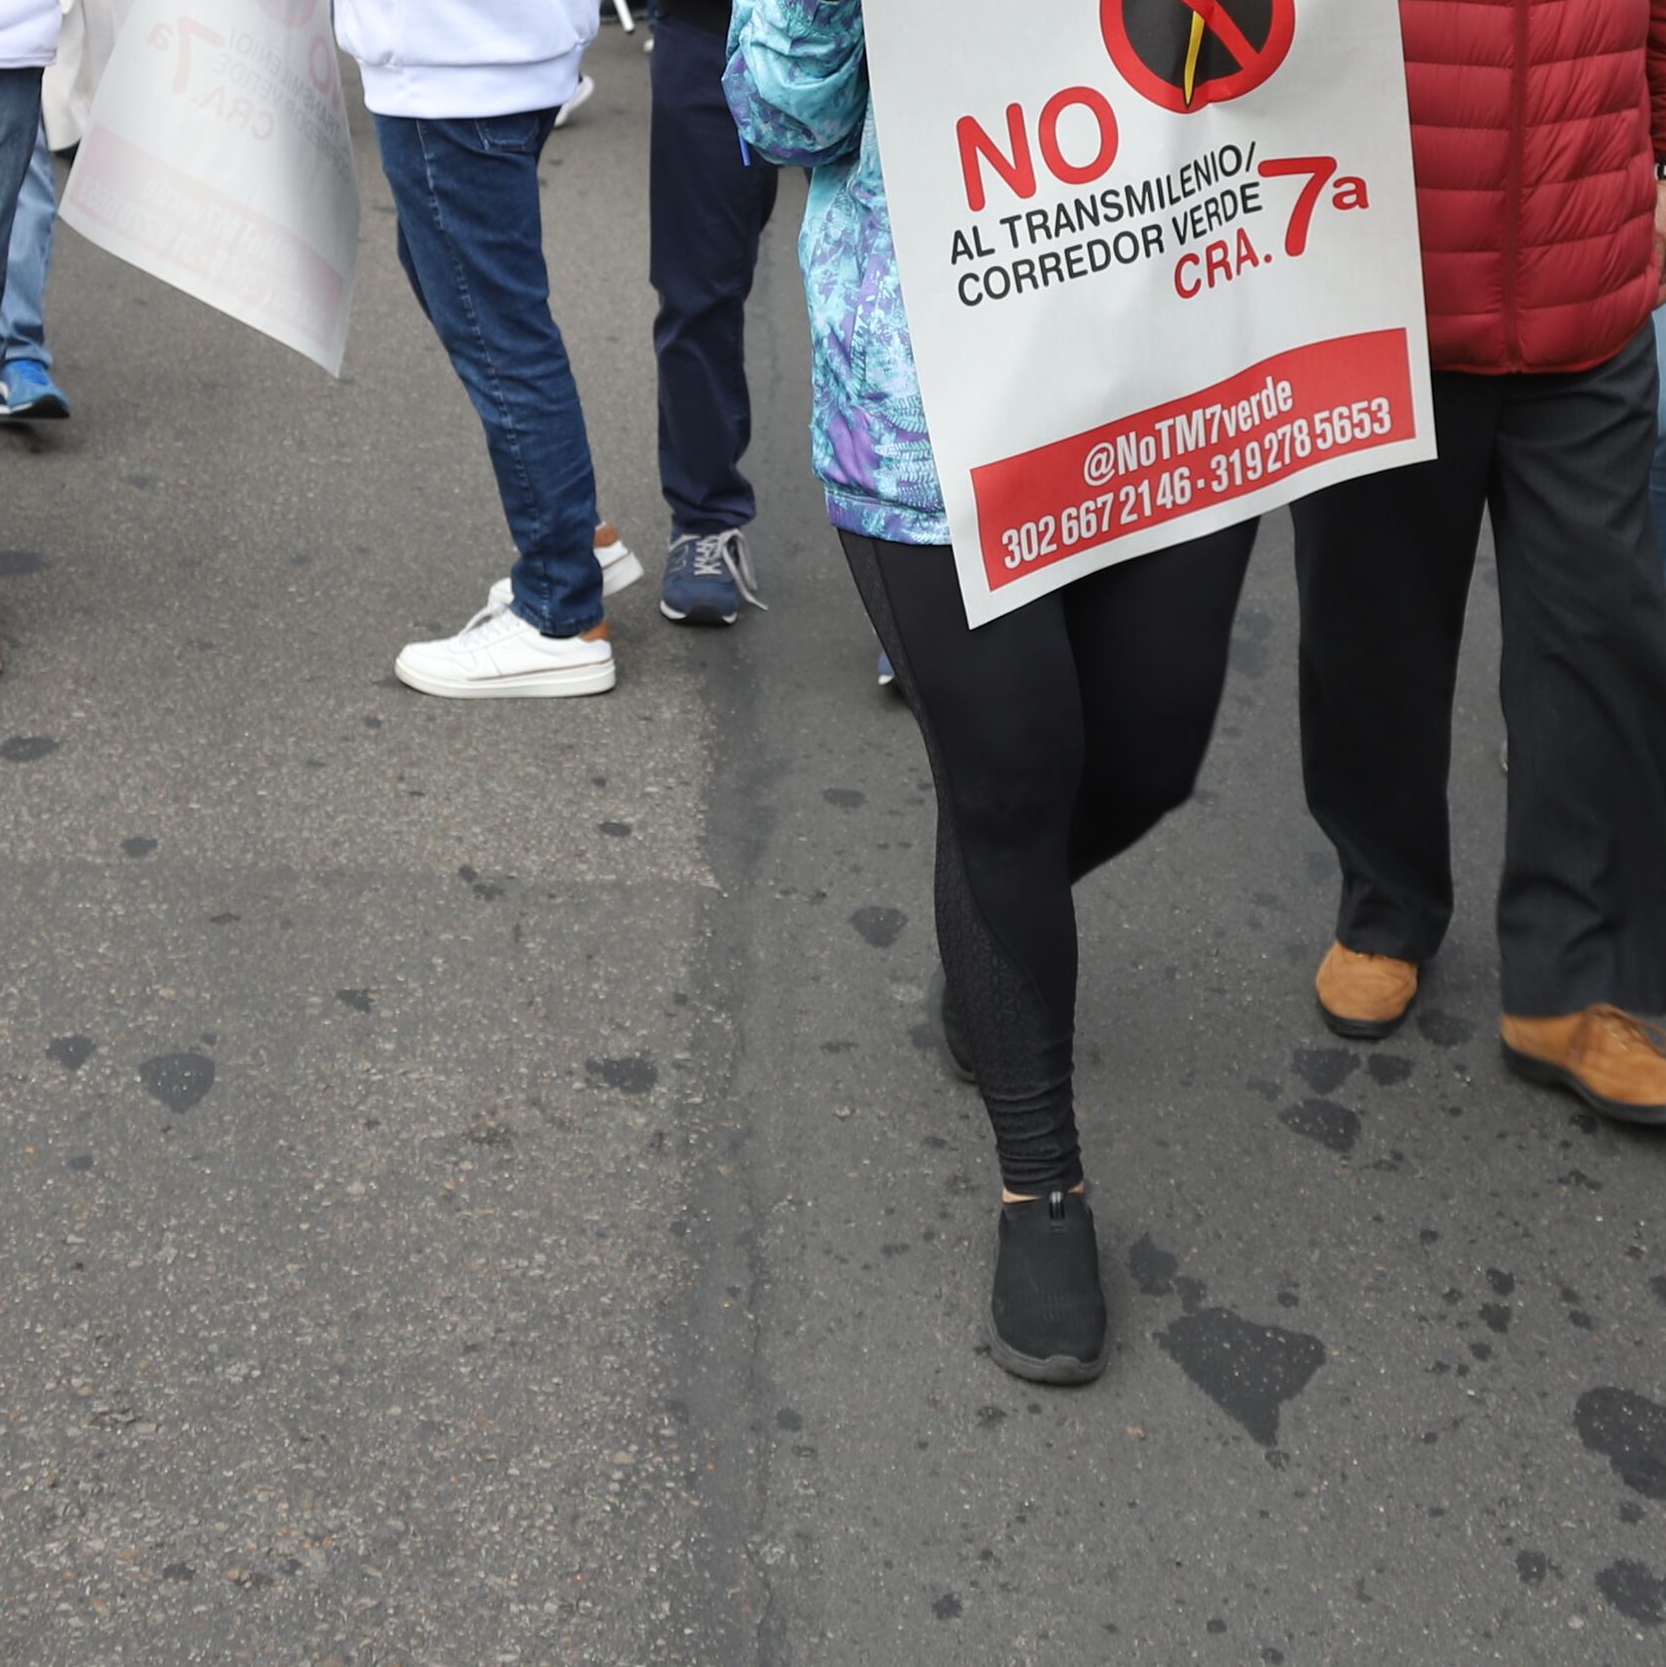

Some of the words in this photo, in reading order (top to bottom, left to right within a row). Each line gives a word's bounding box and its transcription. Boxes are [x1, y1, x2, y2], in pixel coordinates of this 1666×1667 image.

[951, 225, 995, 265] AL
[1000, 141, 1256, 249] TRANSMILENIO/
[956, 86, 1119, 212] NO
[957, 223, 1164, 307] CORREDOR
[1172, 181, 1264, 246] VERDE
[1174, 227, 1274, 300] CRA.
[1001, 514, 1057, 570] 302
[1060, 491, 1114, 547] 667
[1118, 465, 1192, 526] 2146
[1210, 441, 1264, 495] 319
[1265, 417, 1312, 474] 278
[1313, 396, 1393, 452] 5653
[1082, 375, 1293, 487] @NoTM7verde
